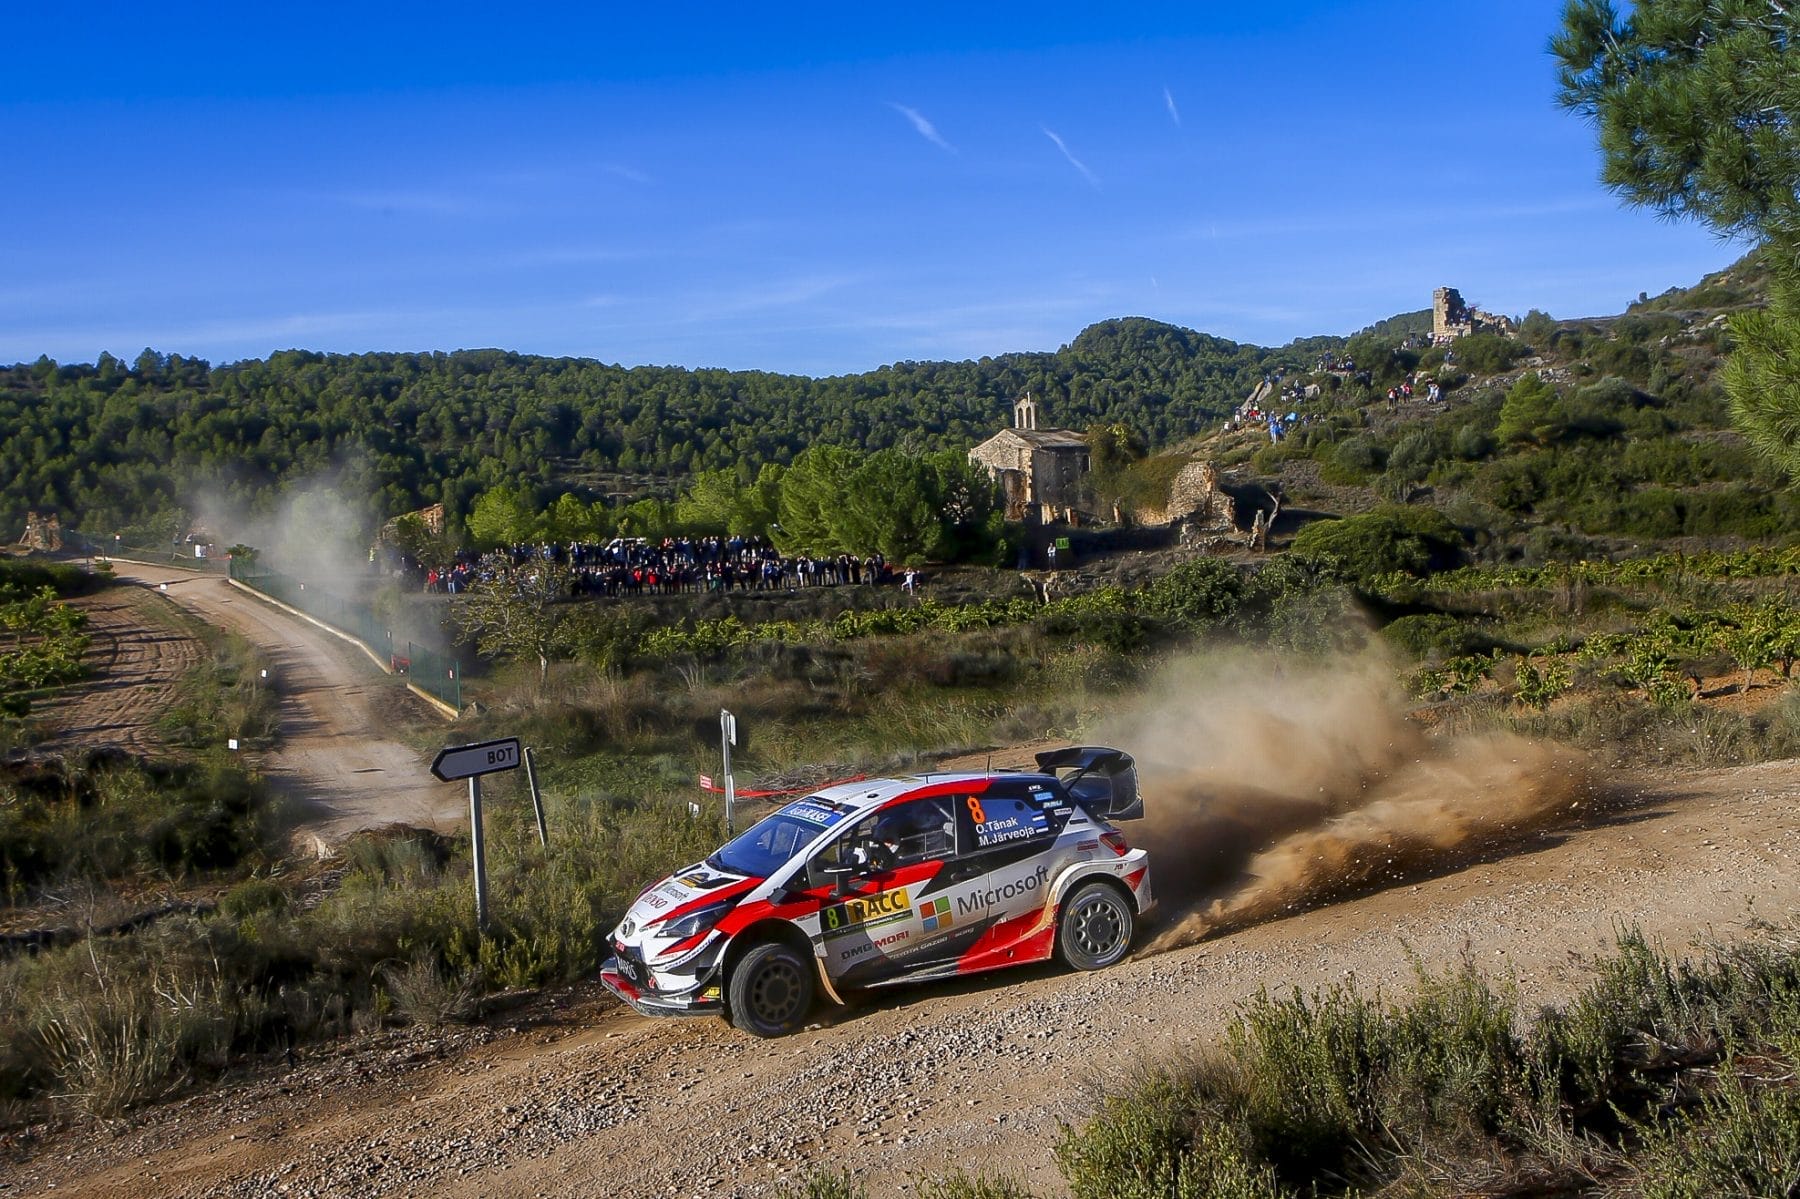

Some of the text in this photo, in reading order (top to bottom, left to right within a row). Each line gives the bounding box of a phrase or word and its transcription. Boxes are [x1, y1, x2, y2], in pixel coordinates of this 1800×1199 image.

[487, 746, 514, 765] BOT
[967, 797, 986, 825] 8
[978, 826, 1036, 848] M.Järveoja
[957, 864, 1051, 916] Microsoft
[826, 907, 839, 930] 8
[852, 890, 904, 921] RACC
[841, 943, 873, 960] DMG
[873, 930, 910, 950] MORI
